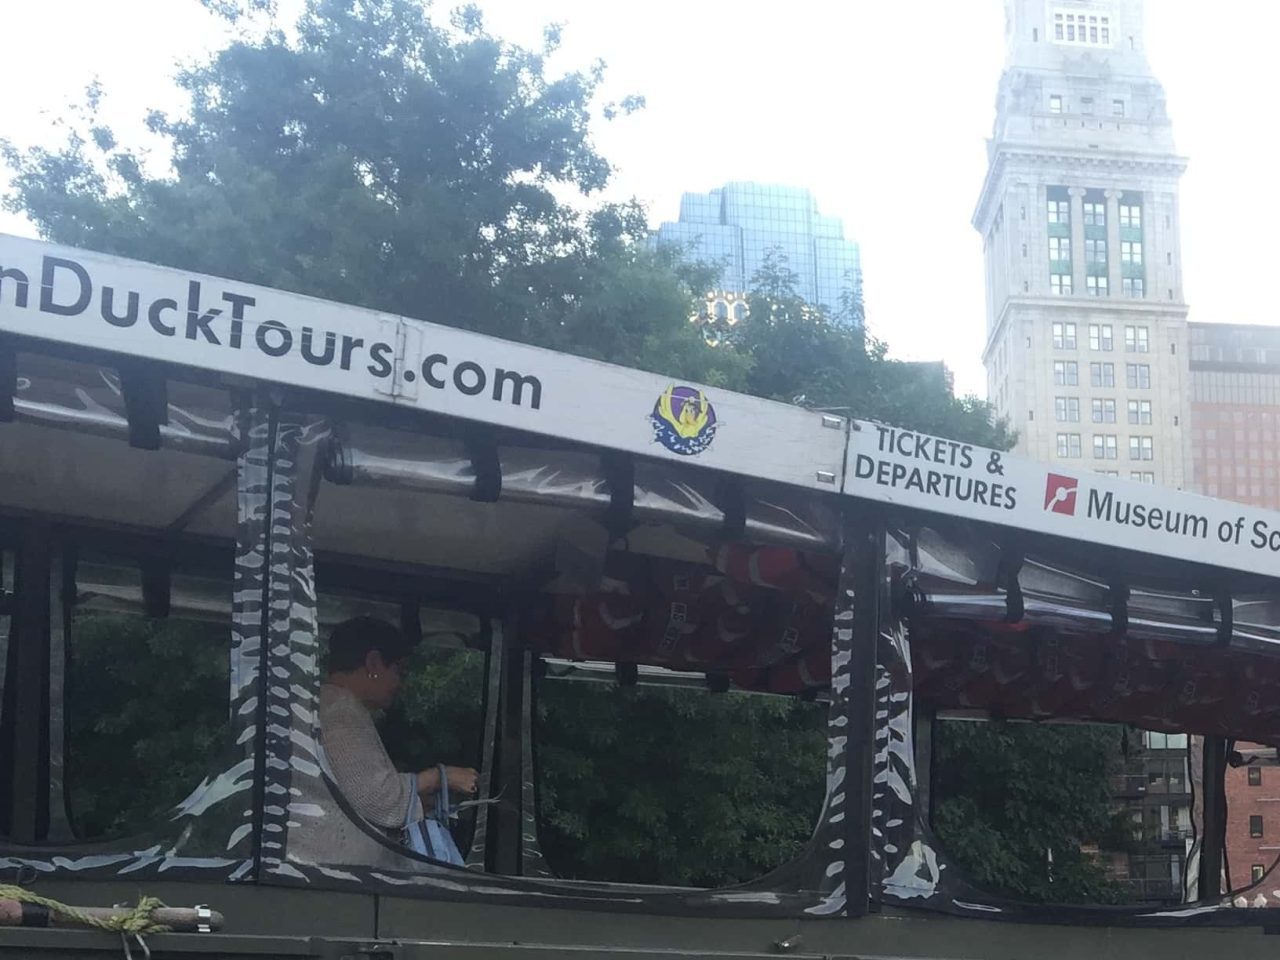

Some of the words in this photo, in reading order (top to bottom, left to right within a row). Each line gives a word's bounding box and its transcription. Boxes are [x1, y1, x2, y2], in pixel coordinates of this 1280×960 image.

[876, 425, 973, 469] TICKETS
[986, 451, 1004, 476] &
[855, 453, 1017, 510] DEPARTURES
[1087, 488, 1208, 539] Museum
[1217, 516, 1245, 545] of
